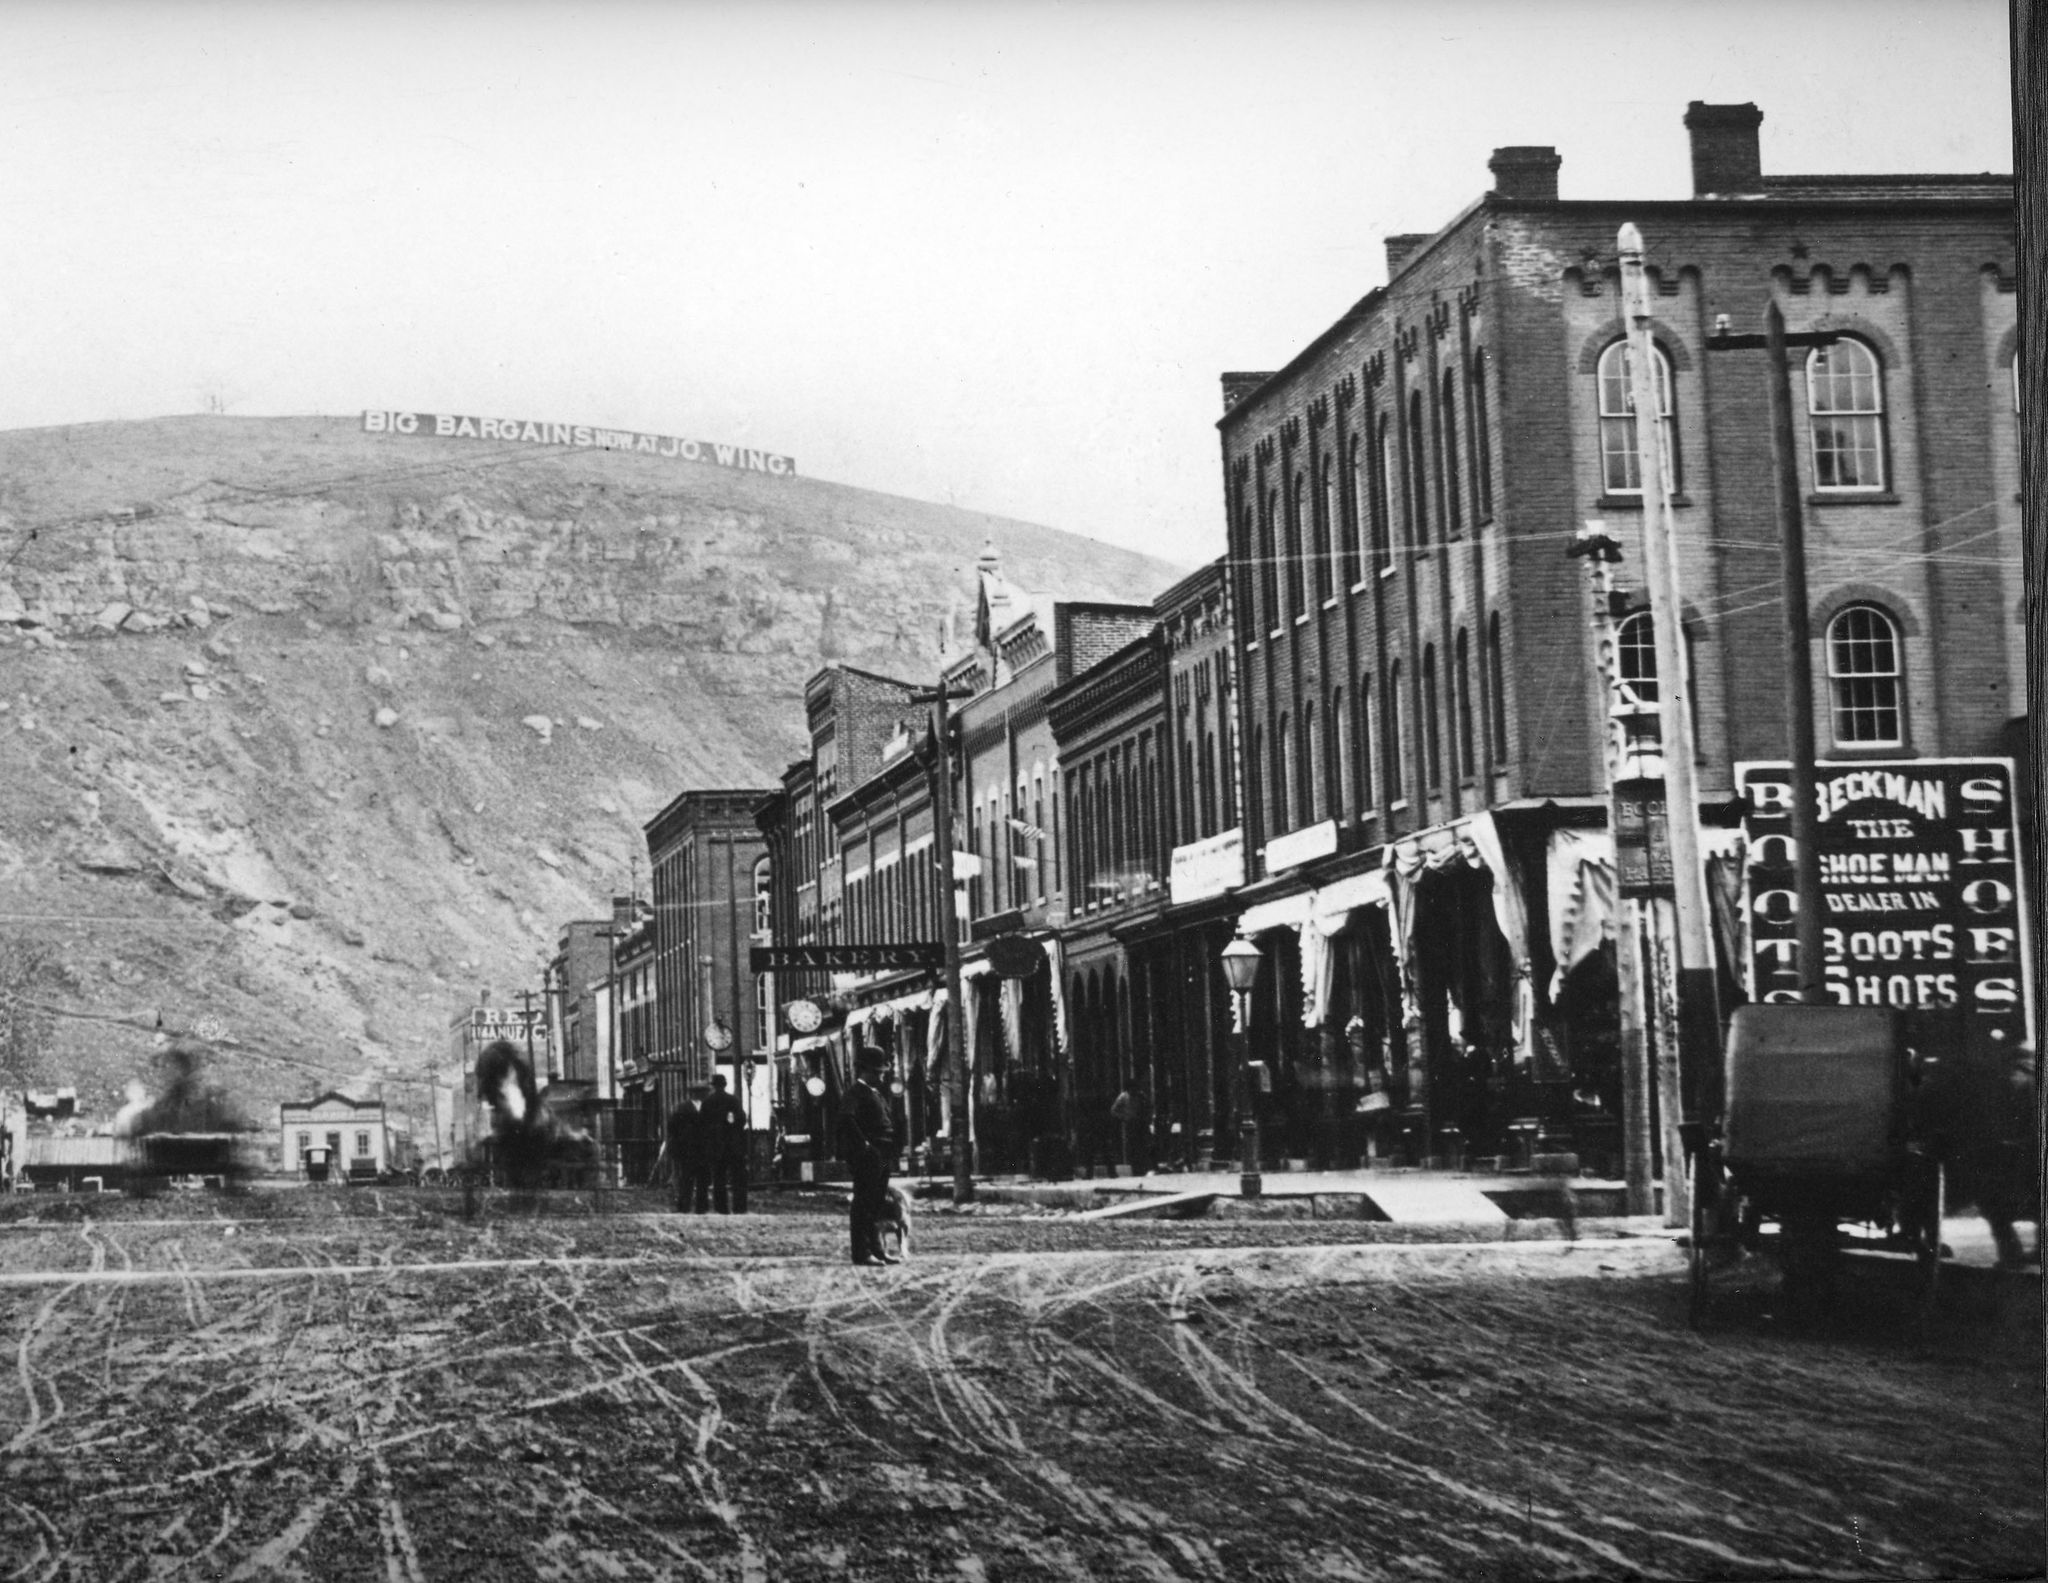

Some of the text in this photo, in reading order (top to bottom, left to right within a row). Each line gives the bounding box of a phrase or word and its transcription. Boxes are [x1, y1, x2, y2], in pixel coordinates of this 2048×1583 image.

[364, 410, 419, 433] BIG
[435, 414, 593, 447] BARGAINS
[636, 435, 659, 453] AT
[1847, 819, 1915, 839] THE
[1893, 853, 1950, 883] MAN
[1825, 891, 1941, 913] DEALER IN
